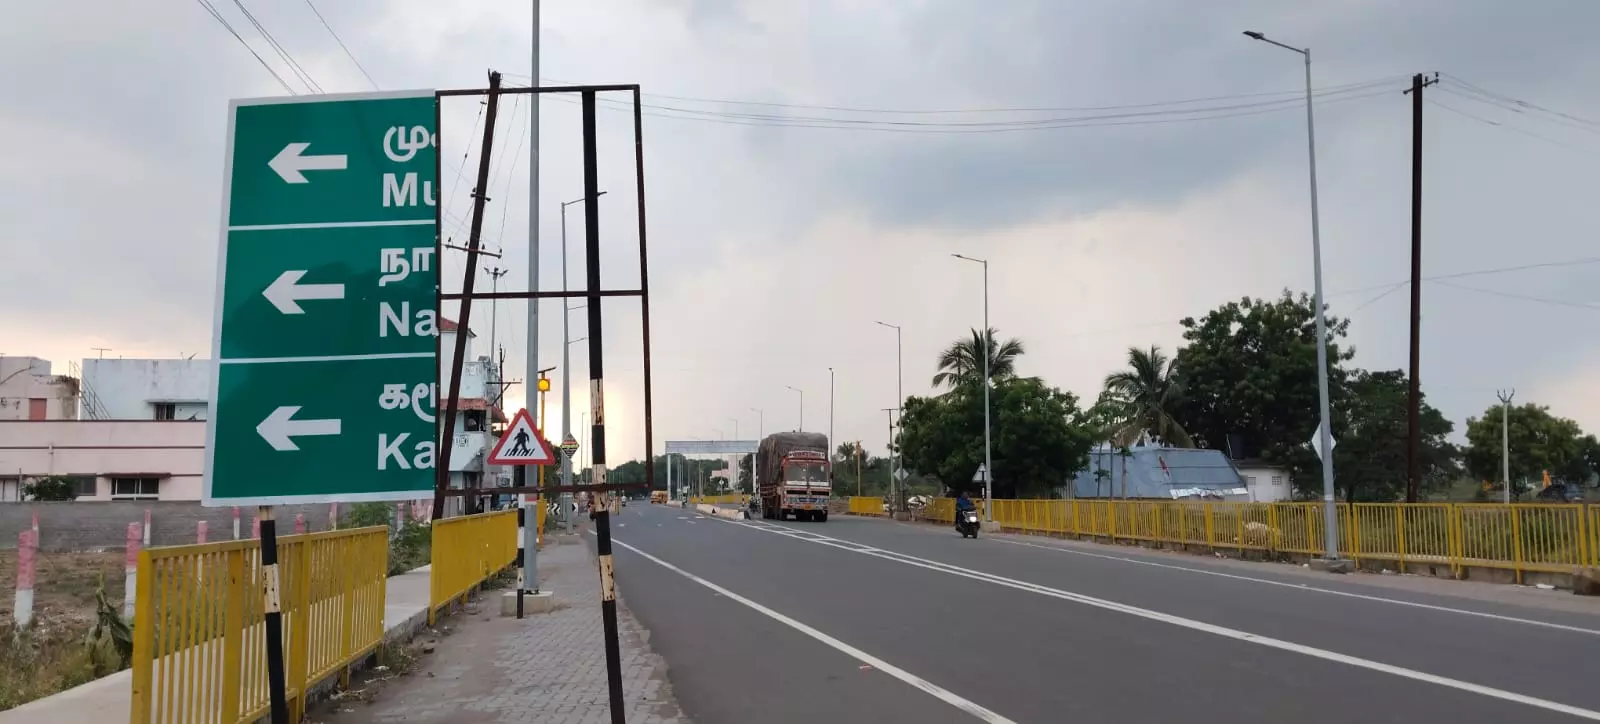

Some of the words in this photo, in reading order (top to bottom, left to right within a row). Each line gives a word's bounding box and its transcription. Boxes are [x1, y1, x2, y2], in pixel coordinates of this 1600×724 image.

[383, 125, 435, 162] மு
[380, 301, 438, 337] Na
[378, 432, 435, 470] Ka
